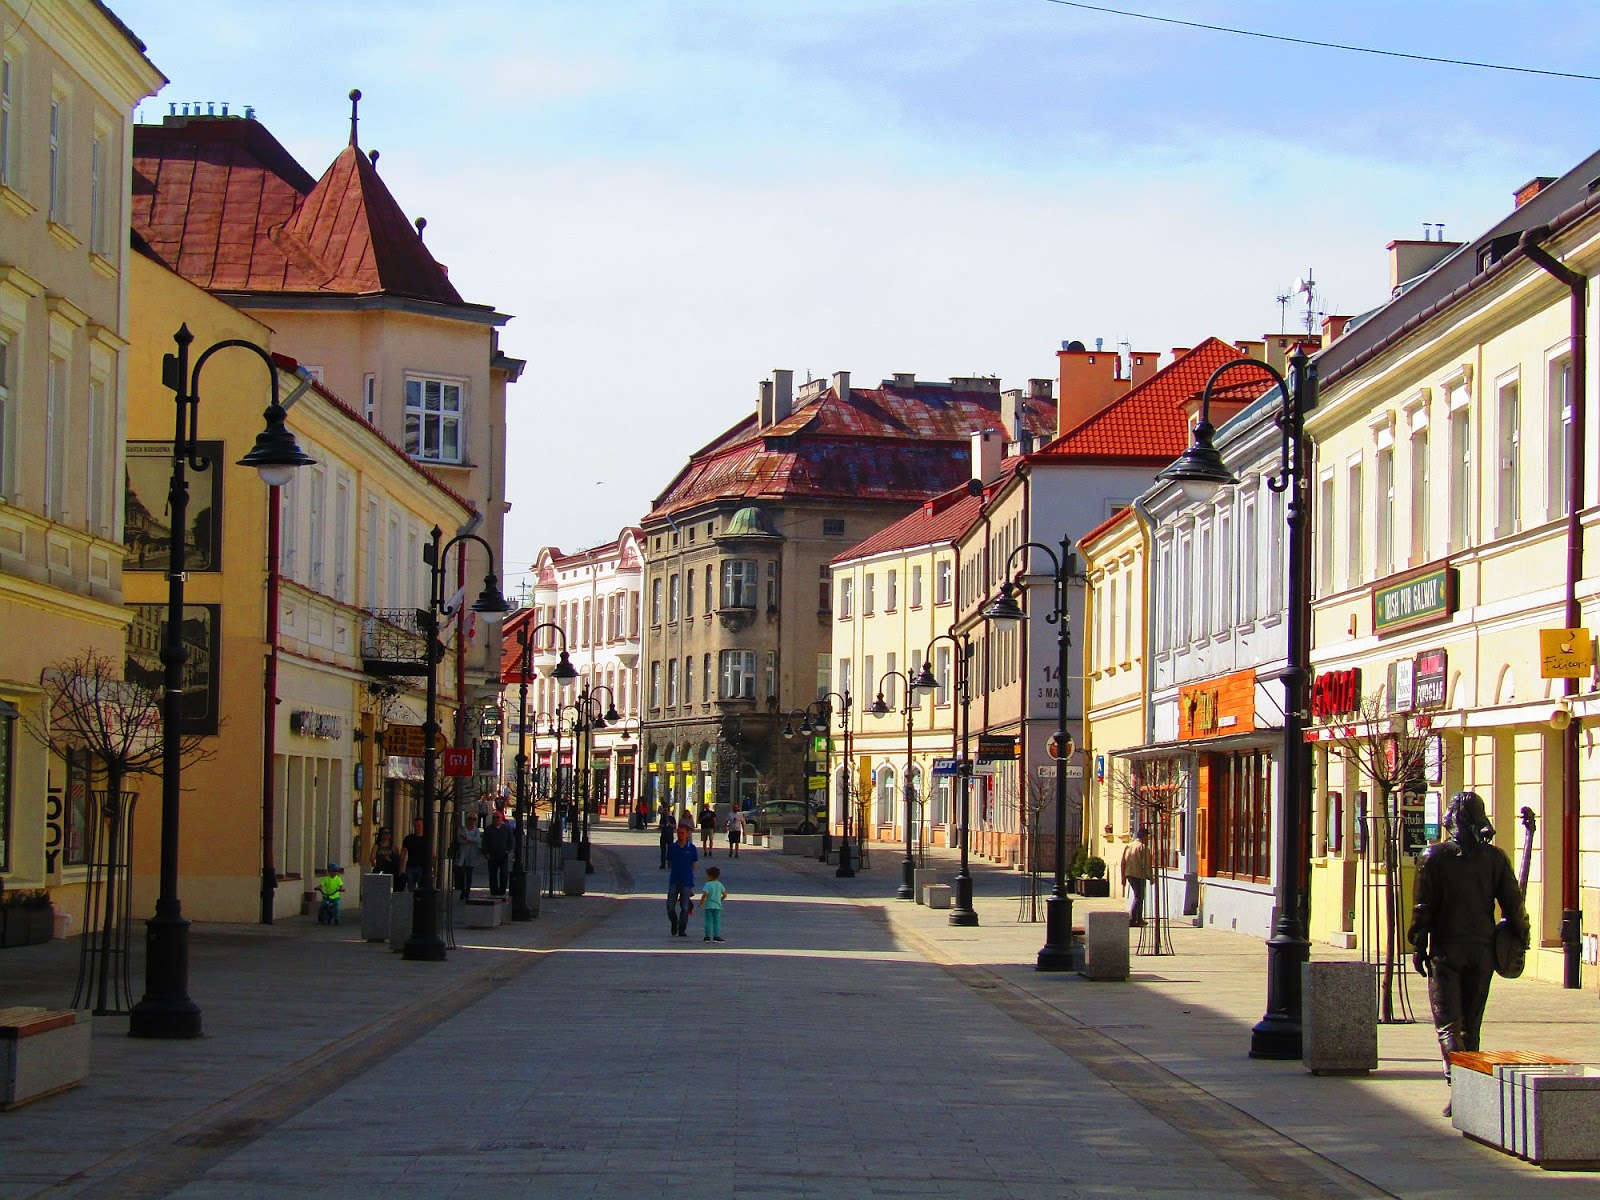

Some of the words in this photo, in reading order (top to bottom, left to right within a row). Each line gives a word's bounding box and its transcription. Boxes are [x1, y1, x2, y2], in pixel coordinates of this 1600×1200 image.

[1385, 591, 1400, 619] IRISH
[1400, 586, 1412, 615] PUB
[1413, 578, 1437, 612] GALWAY
[1038, 688, 1043, 698] 3
[1046, 687, 1070, 698] MAA
[934, 761, 955, 769] LOT
[1404, 812, 1424, 830] studio
